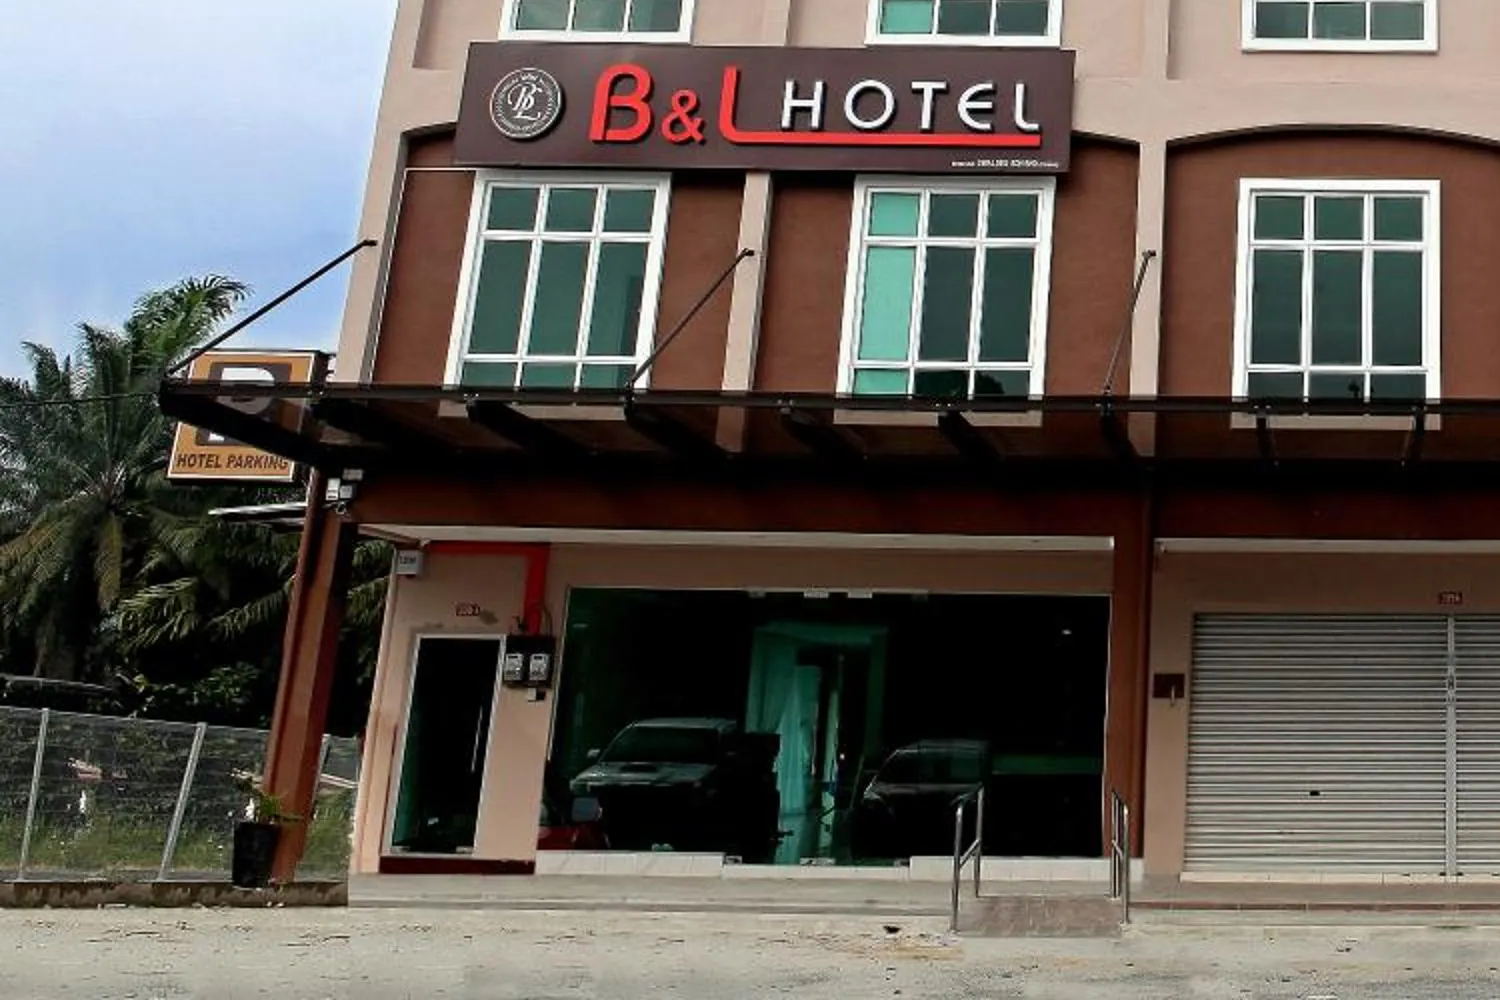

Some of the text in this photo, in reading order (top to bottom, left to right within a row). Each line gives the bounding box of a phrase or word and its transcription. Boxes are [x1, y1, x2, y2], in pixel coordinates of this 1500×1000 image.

[780, 79, 1042, 133] HOTEL
[176, 453, 290, 470] HOTEL PARKING
